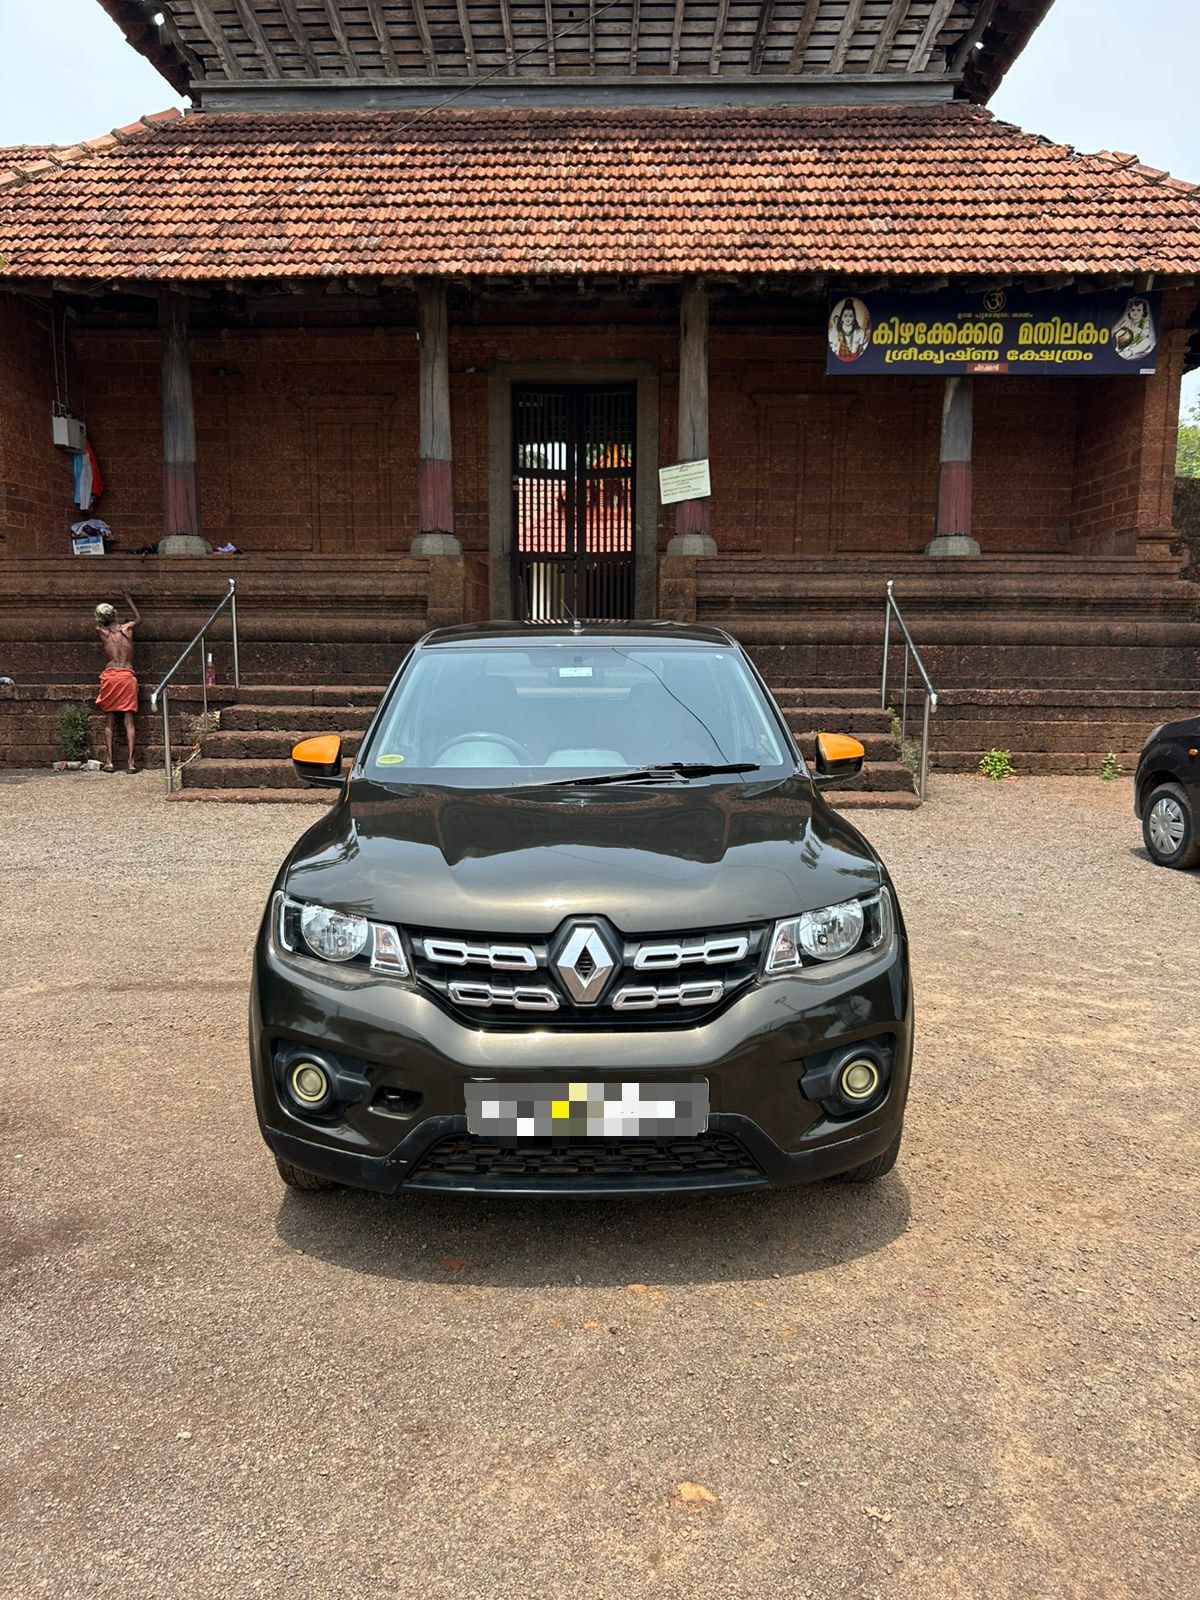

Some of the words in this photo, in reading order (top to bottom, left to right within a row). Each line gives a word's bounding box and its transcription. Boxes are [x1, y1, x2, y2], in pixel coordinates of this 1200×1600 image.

[872, 316, 1003, 345] കിഴക്കേക്കര
[1018, 316, 1110, 345] മതിലകം
[885, 347, 999, 364] ശ്രീകൃഷ്ണ
[1006, 349, 1094, 364] ക്ഷേത്രം
